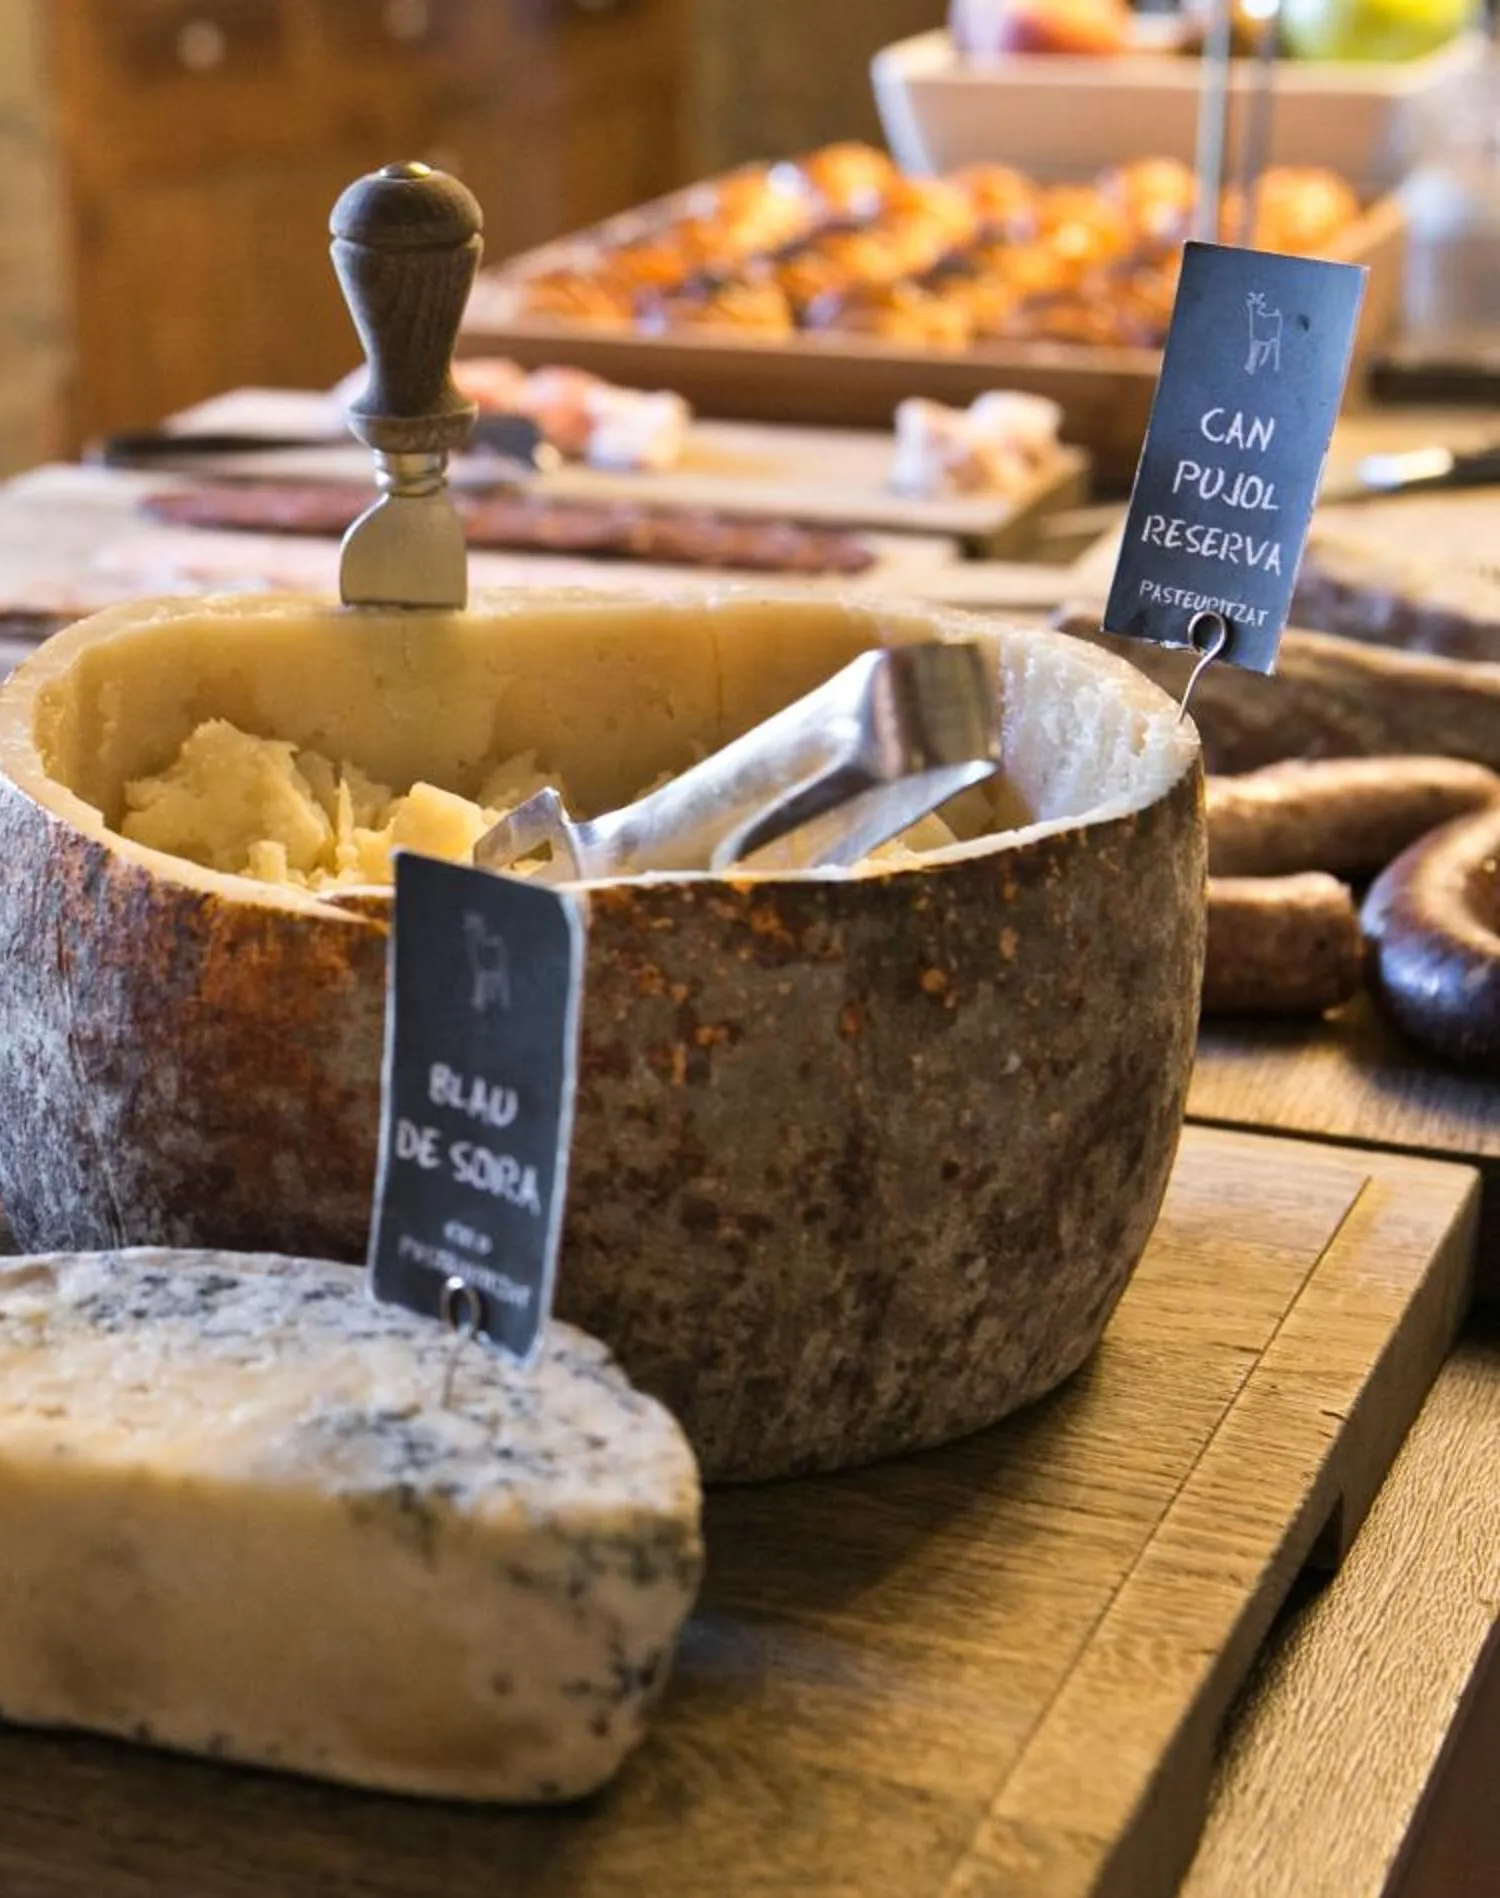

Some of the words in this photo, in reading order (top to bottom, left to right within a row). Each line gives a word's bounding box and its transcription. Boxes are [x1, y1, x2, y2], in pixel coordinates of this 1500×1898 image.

[1201, 407, 1275, 452] CAN
[1172, 460, 1280, 510] PUJOL
[1141, 514, 1282, 577] RESERVA
[428, 1062, 519, 1128] BLAU
[396, 1119, 442, 1170] DE
[449, 1140, 542, 1216] SORA
